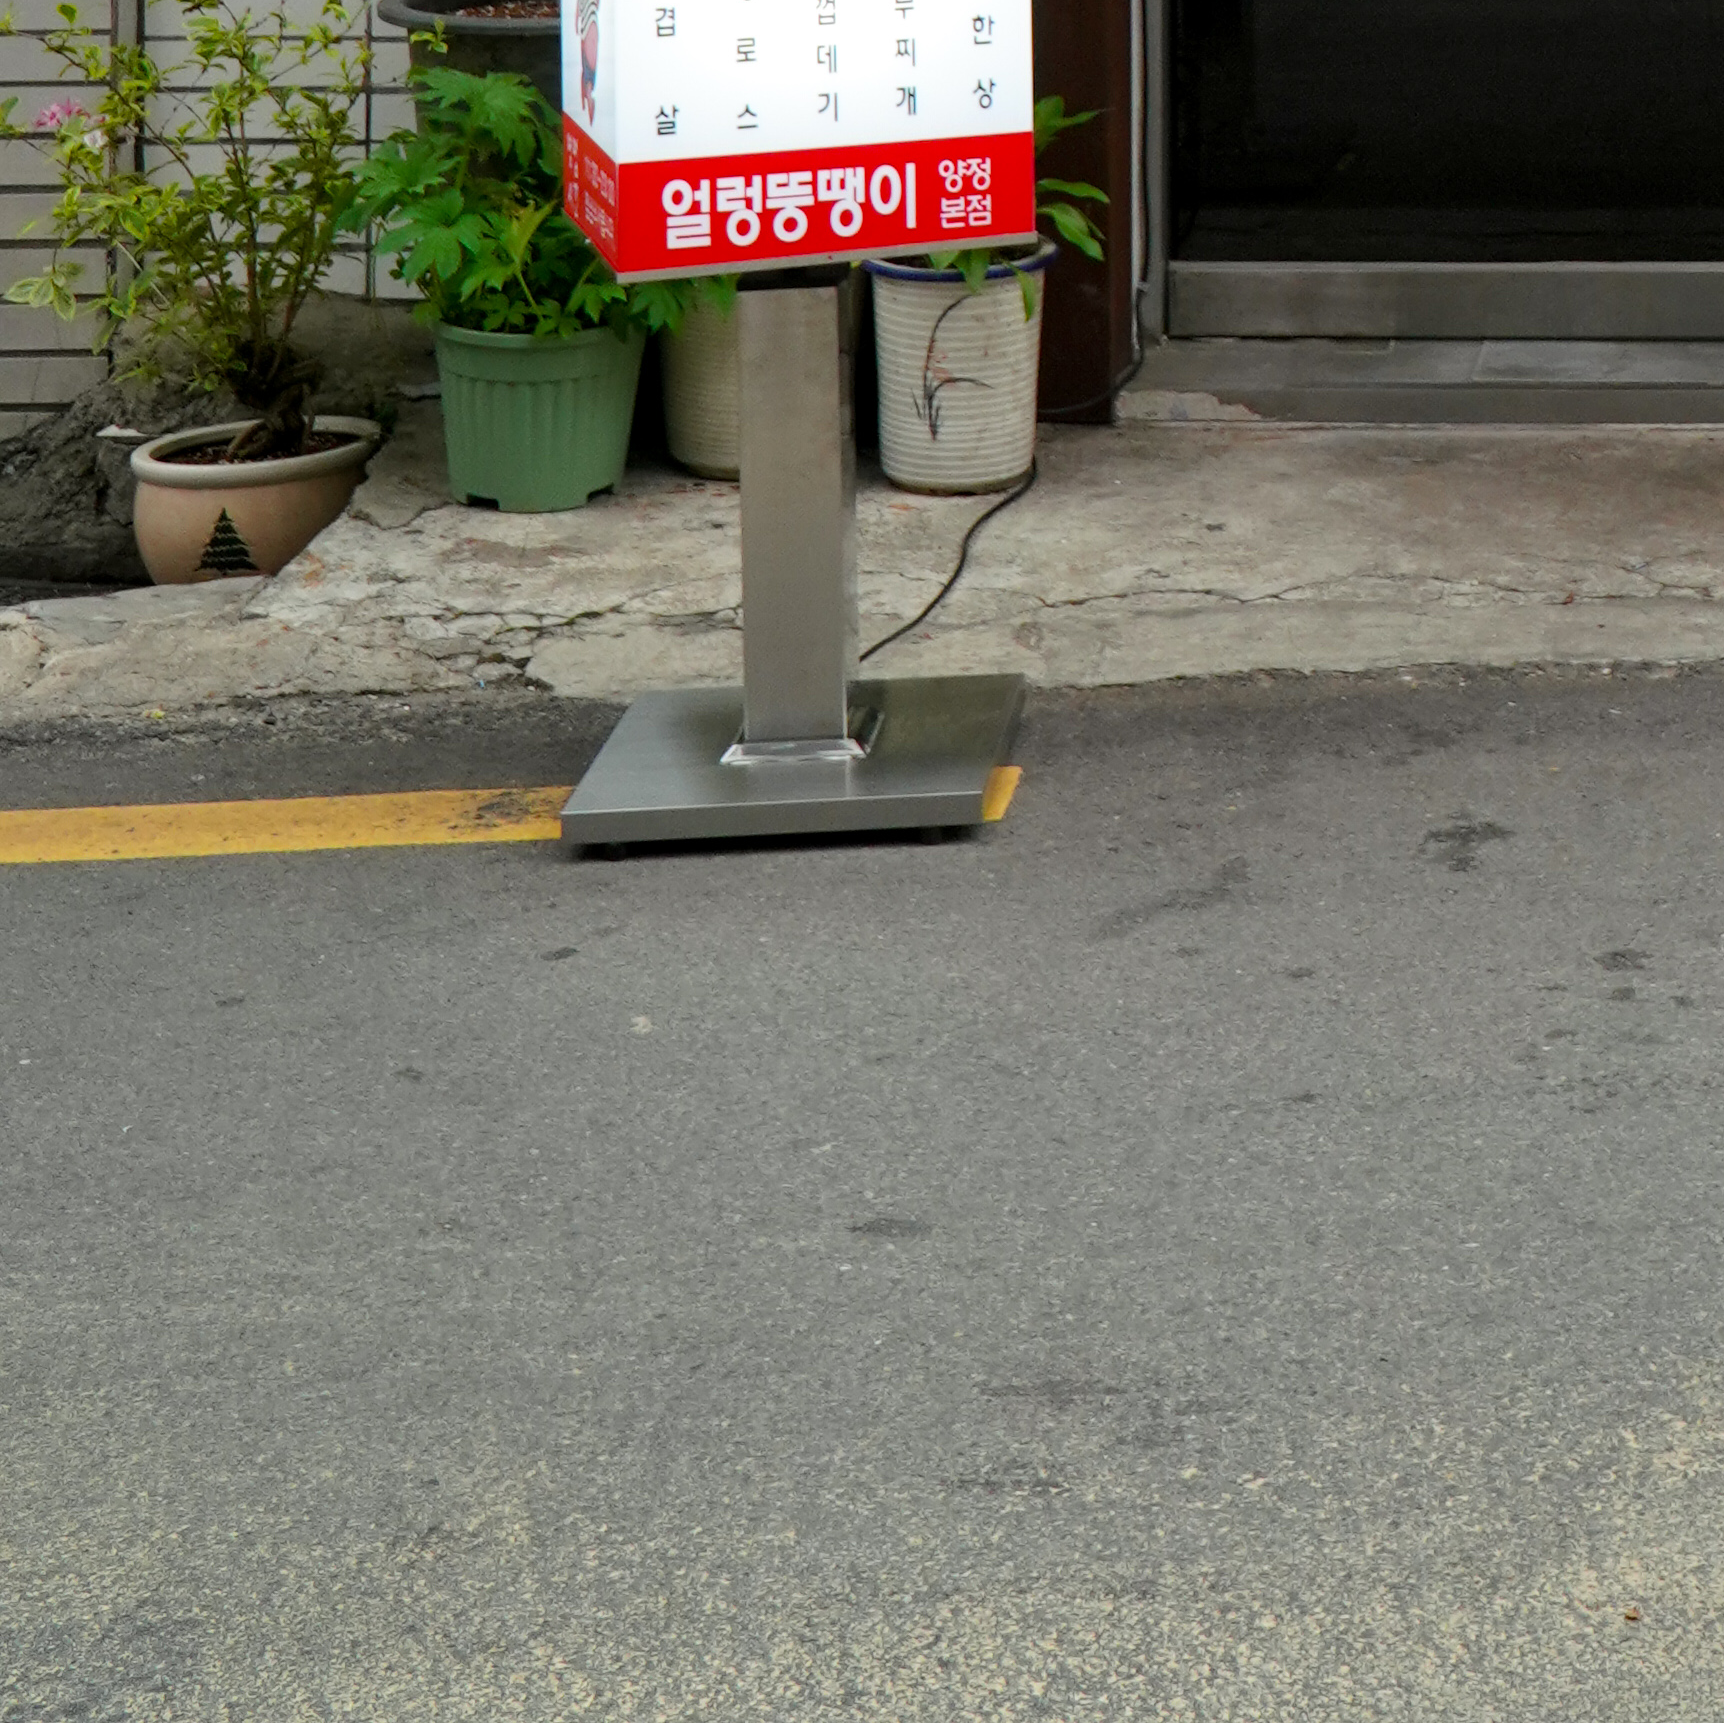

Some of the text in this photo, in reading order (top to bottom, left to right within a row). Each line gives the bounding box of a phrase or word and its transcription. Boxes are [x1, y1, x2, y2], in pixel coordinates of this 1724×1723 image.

[938, 157, 992, 191] 양정
[661, 162, 917, 250] 얼렁뚱땡이
[939, 193, 992, 229] 본점
